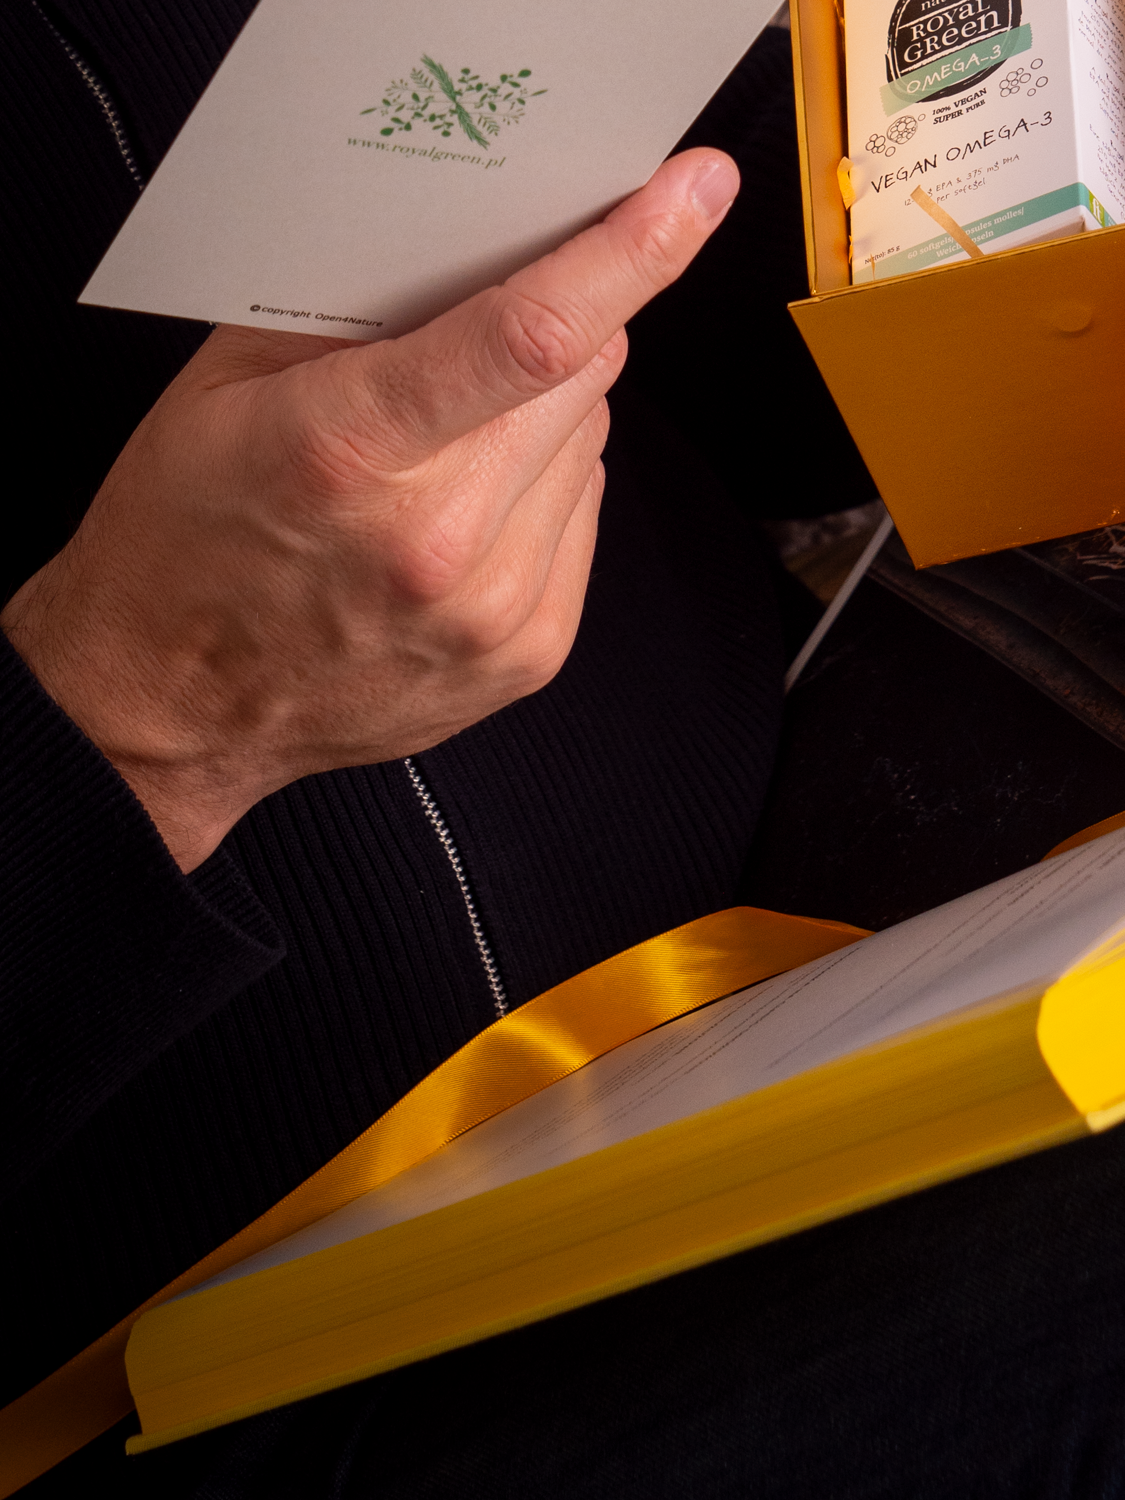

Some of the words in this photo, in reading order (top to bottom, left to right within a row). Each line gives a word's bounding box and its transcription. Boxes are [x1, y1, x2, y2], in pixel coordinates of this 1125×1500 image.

[906, 44, 1002, 94] OMEGA-3
[932, 105, 952, 116] 100%
[953, 87, 988, 108] VEGAN
[933, 109, 964, 125] SUPER
[966, 99, 986, 114] PURE
[347, 137, 507, 170] www.royalgreen.pl
[870, 154, 938, 193] VEGAN
[946, 111, 1053, 161] OMEGA-3
[936, 180, 953, 192] EPA
[966, 167, 982, 180] 375
[1003, 154, 1020, 165] DHA
[936, 193, 950, 203] per
[954, 178, 986, 196] softgel
[887, 247, 895, 255] 85
[907, 250, 918, 259] 60
[315, 312, 383, 328] Open4Nature
